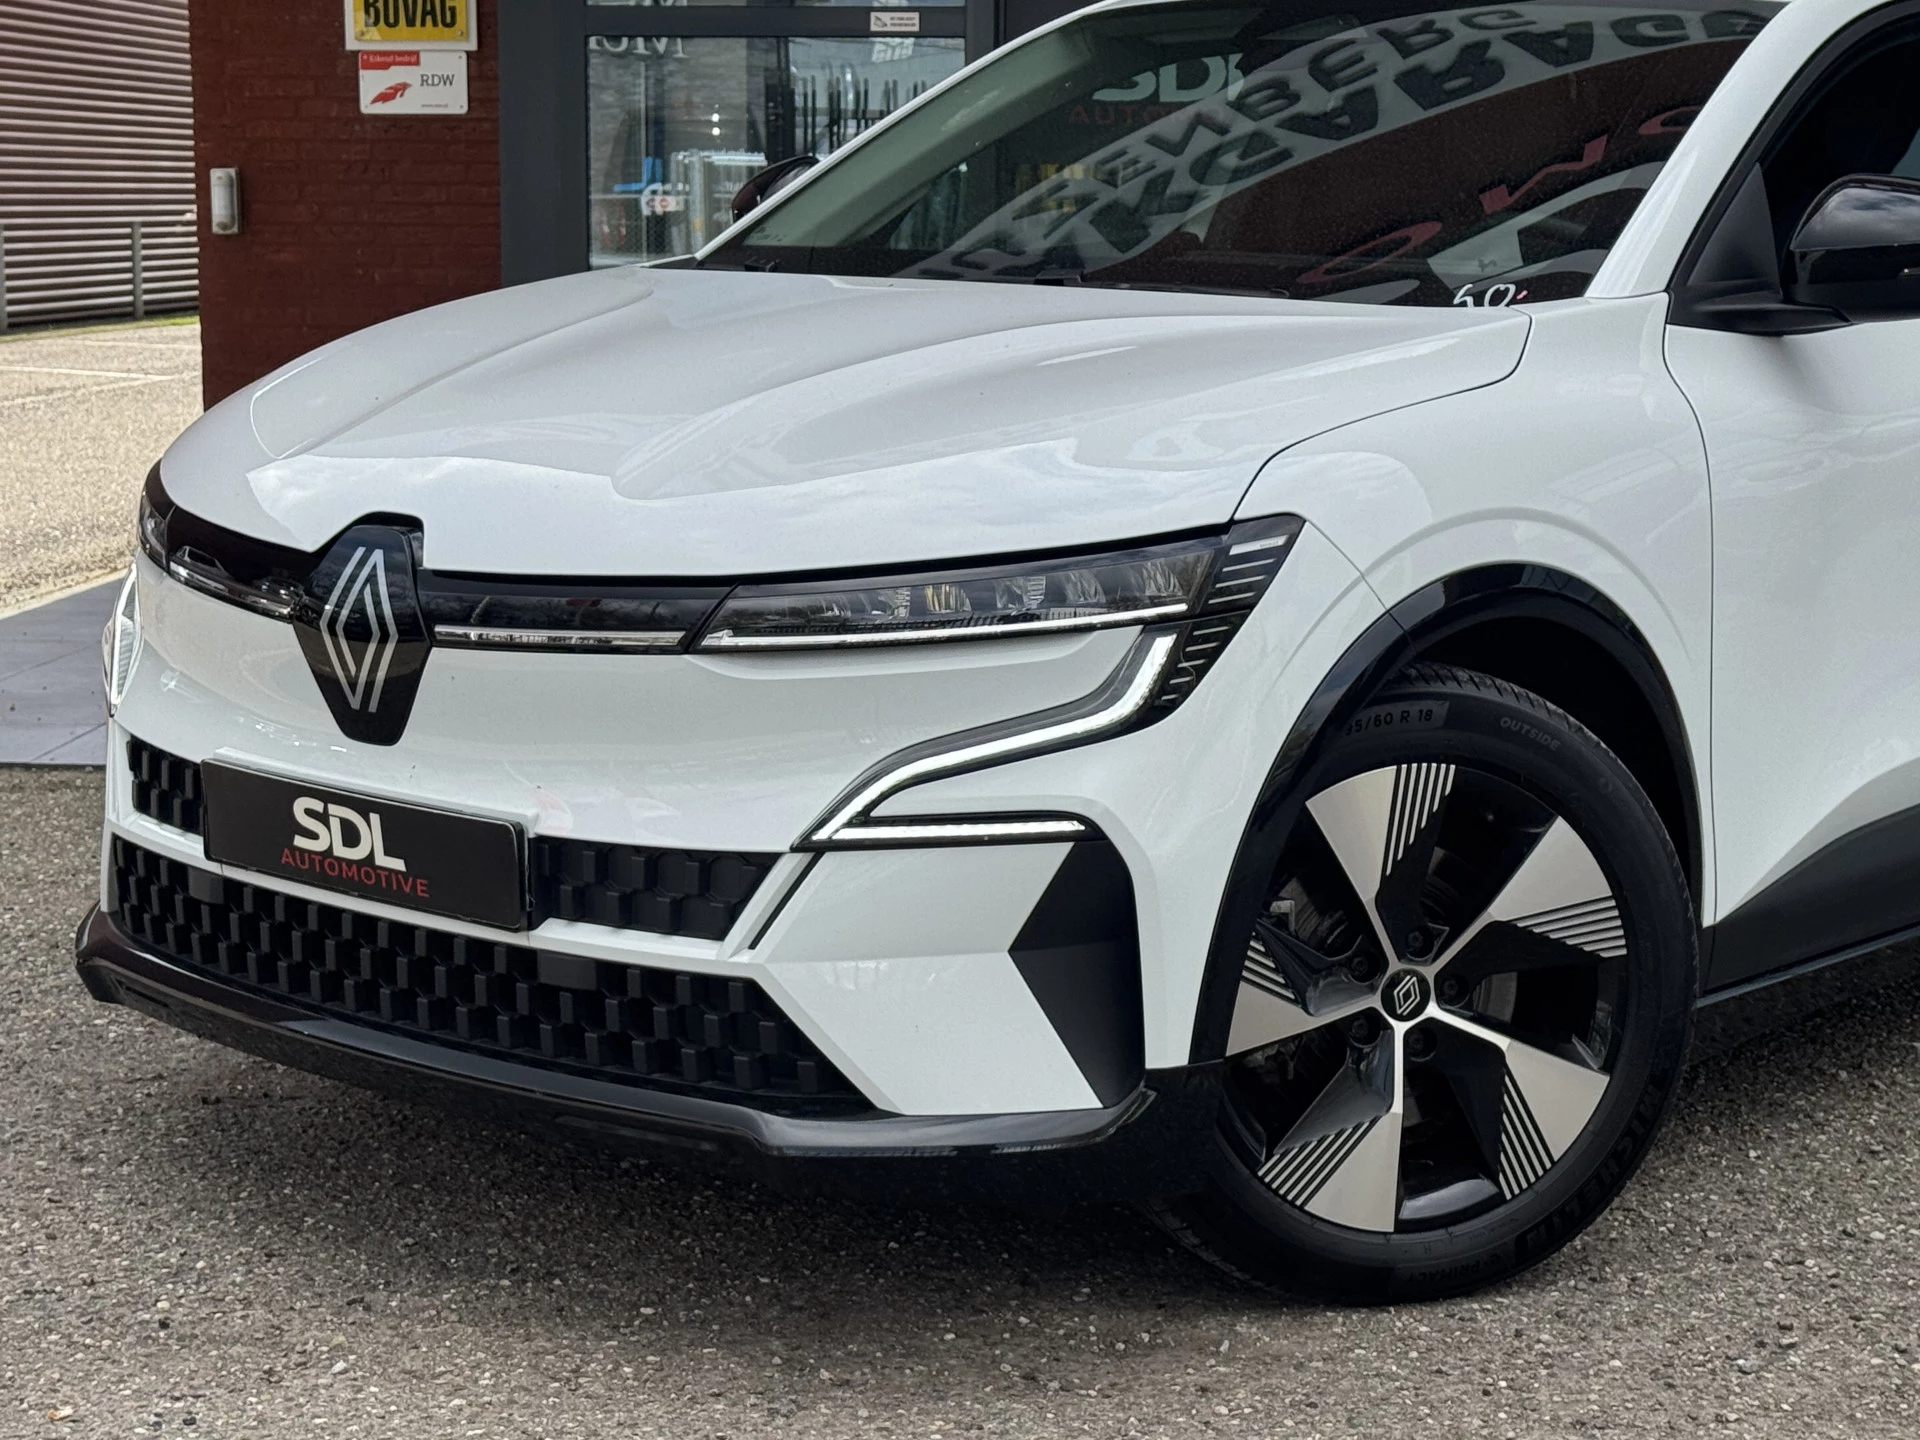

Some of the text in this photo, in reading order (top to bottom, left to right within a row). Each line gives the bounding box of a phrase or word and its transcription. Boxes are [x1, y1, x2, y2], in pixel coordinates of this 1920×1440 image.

[364, 0, 457, 28] BOVAG
[419, 73, 455, 87] RDW
[1400, 710, 1411, 724] R
[1418, 709, 1433, 722] 18
[1499, 716, 1562, 751] OUTSIDE
[292, 796, 407, 872] SDL
[280, 847, 431, 898] AUTOMOTIVE
